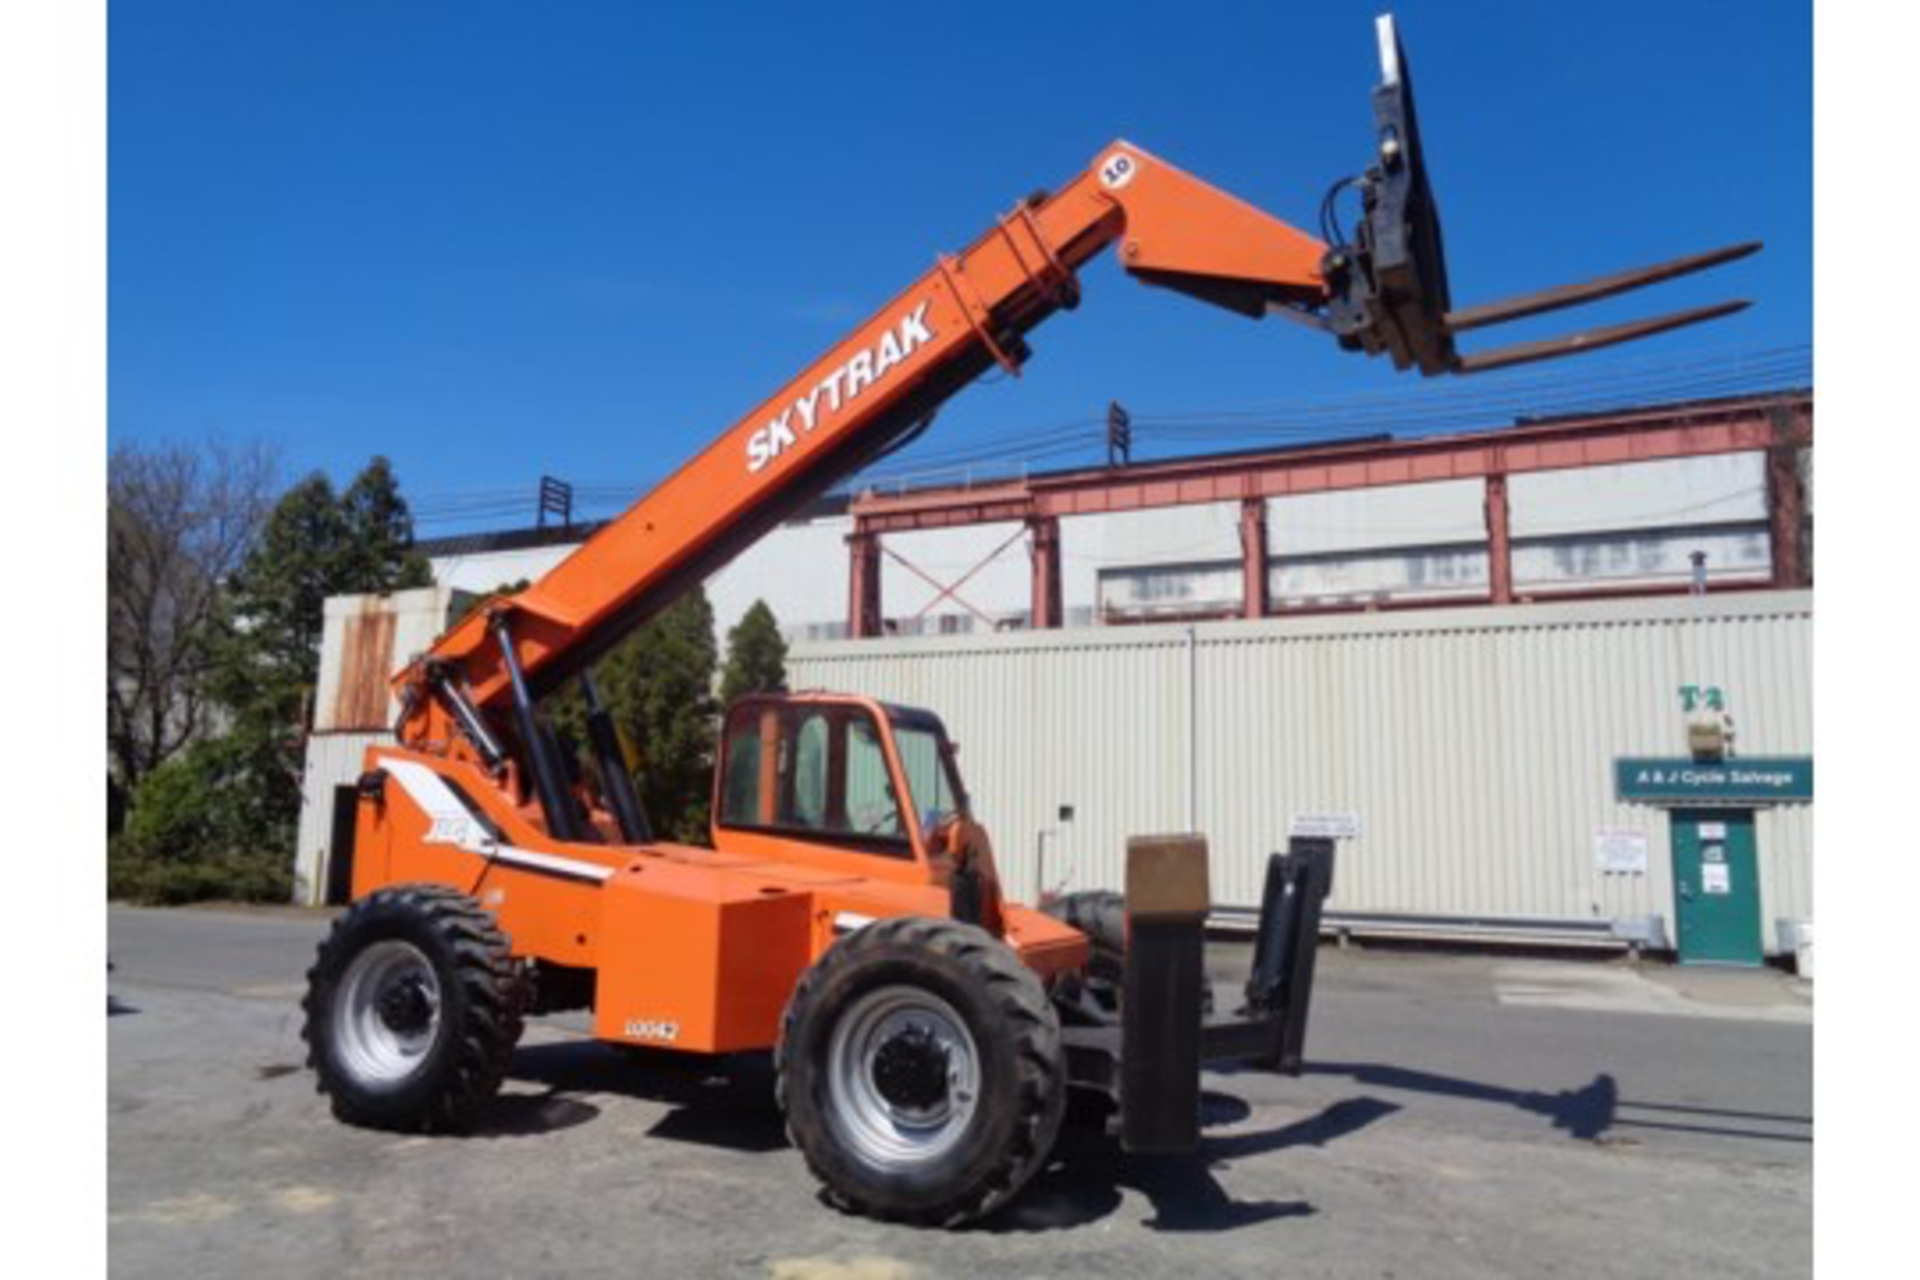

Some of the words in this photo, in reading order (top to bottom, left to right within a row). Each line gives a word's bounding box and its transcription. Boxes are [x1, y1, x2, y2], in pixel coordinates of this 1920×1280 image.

[1105, 157, 1131, 185] 10
[746, 300, 934, 473] SKYTRAK
[1637, 770, 1649, 783] A
[1653, 770, 1664, 783] &
[1667, 770, 1678, 783] J
[1681, 770, 1725, 786] Cycle
[1730, 769, 1793, 787] Salvage
